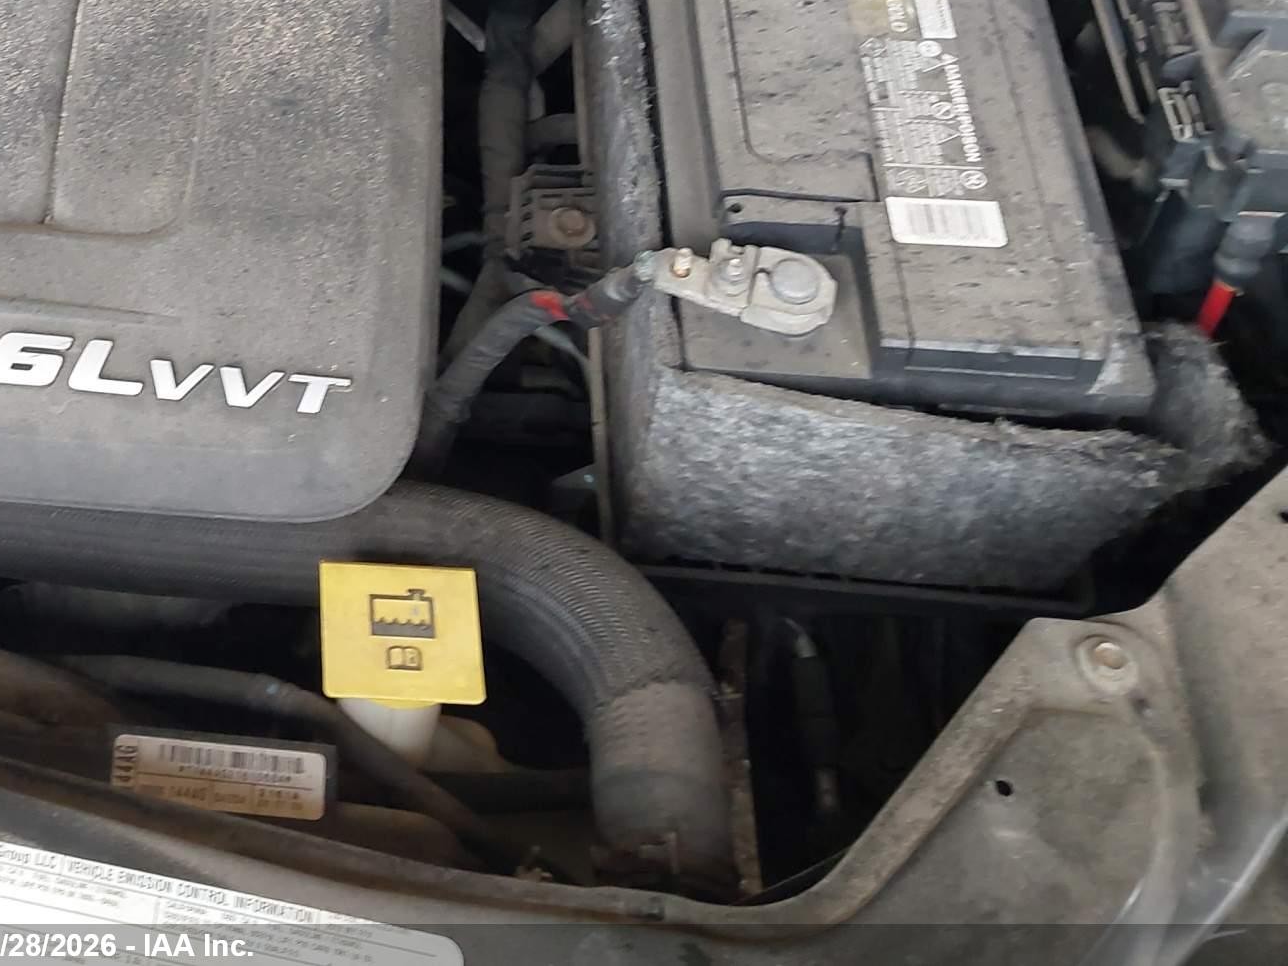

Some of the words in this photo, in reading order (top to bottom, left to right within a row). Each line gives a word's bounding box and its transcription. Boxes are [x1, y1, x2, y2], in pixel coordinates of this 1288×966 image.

[150, 359, 351, 414] VVT
[35, 854, 56, 869] LLC
[68, 861, 113, 881] VEHICLE
[118, 870, 172, 893] EMISSION
[177, 883, 229, 906] CONTROL
[233, 895, 312, 922] INFORMATION
